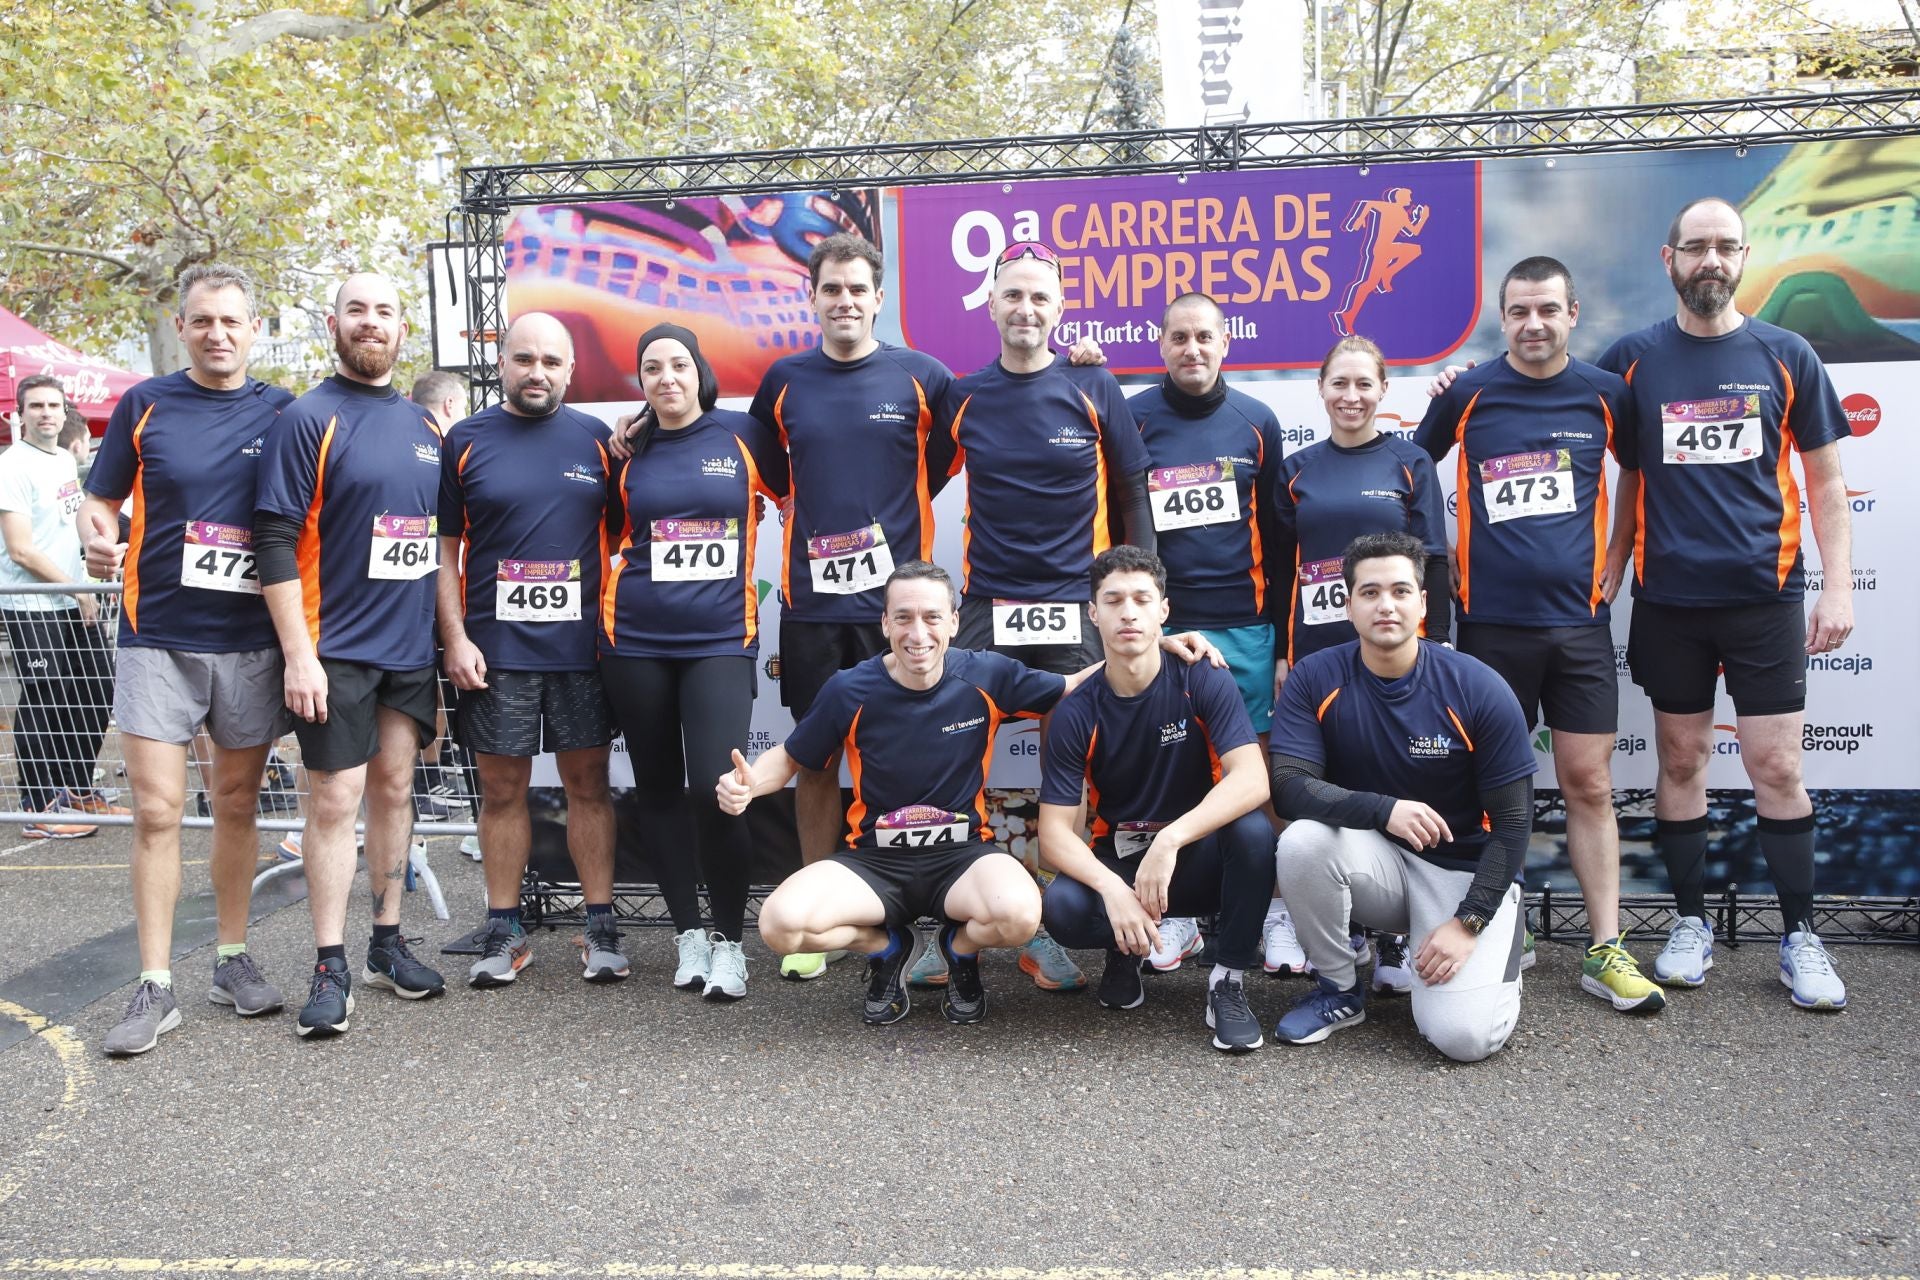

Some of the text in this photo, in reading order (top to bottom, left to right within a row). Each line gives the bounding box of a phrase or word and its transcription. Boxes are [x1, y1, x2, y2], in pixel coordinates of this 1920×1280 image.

[1052, 196, 1260, 250] CARRERA
[1274, 193, 1332, 241] DE
[1060, 246, 1332, 309] EMPRESAS
[1677, 423, 1744, 450] 467
[1163, 486, 1225, 515] 468
[1495, 476, 1559, 506] 473
[195, 549, 259, 580] 472
[383, 541, 429, 567] 464
[663, 543, 725, 568] 470
[822, 552, 877, 583] 471
[1866, 568, 1876, 576] de
[507, 584, 568, 609] 469
[1312, 583, 1346, 610] 46
[1005, 607, 1066, 632] 465
[757, 731, 769, 740] DE
[1803, 724, 1873, 737] Renault
[1802, 738, 1860, 754] Group
